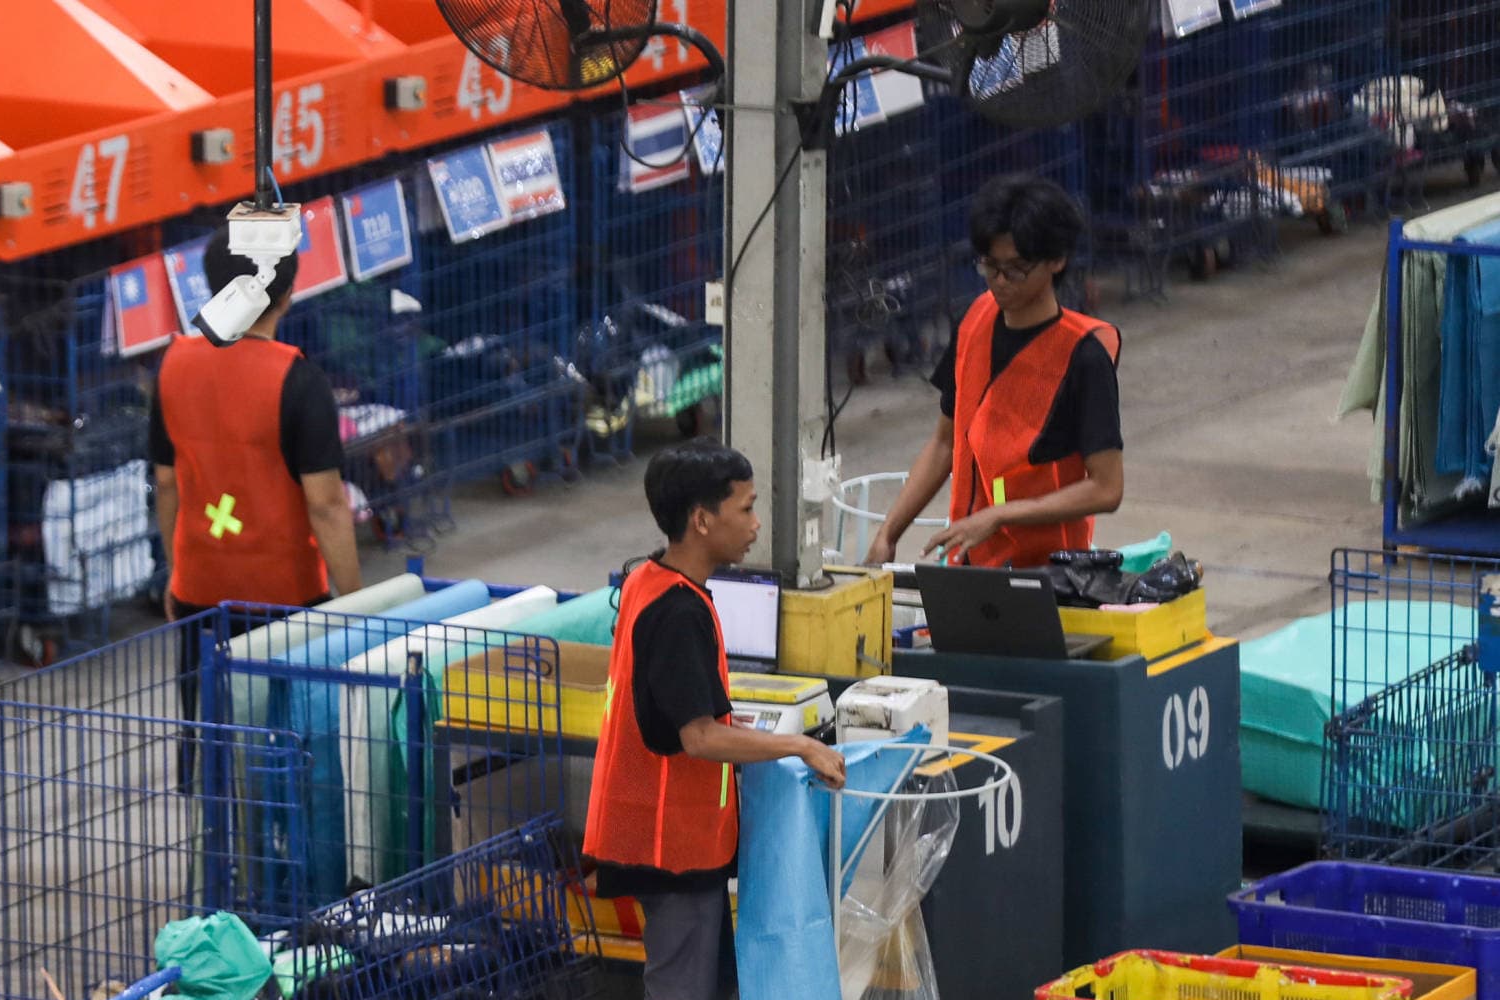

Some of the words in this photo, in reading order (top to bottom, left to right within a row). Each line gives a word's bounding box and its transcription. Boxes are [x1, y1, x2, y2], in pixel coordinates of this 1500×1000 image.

[272, 83, 325, 175] 45
[70, 135, 129, 229] 47
[1161, 685, 1211, 771] 09
[978, 771, 1022, 856] 10
